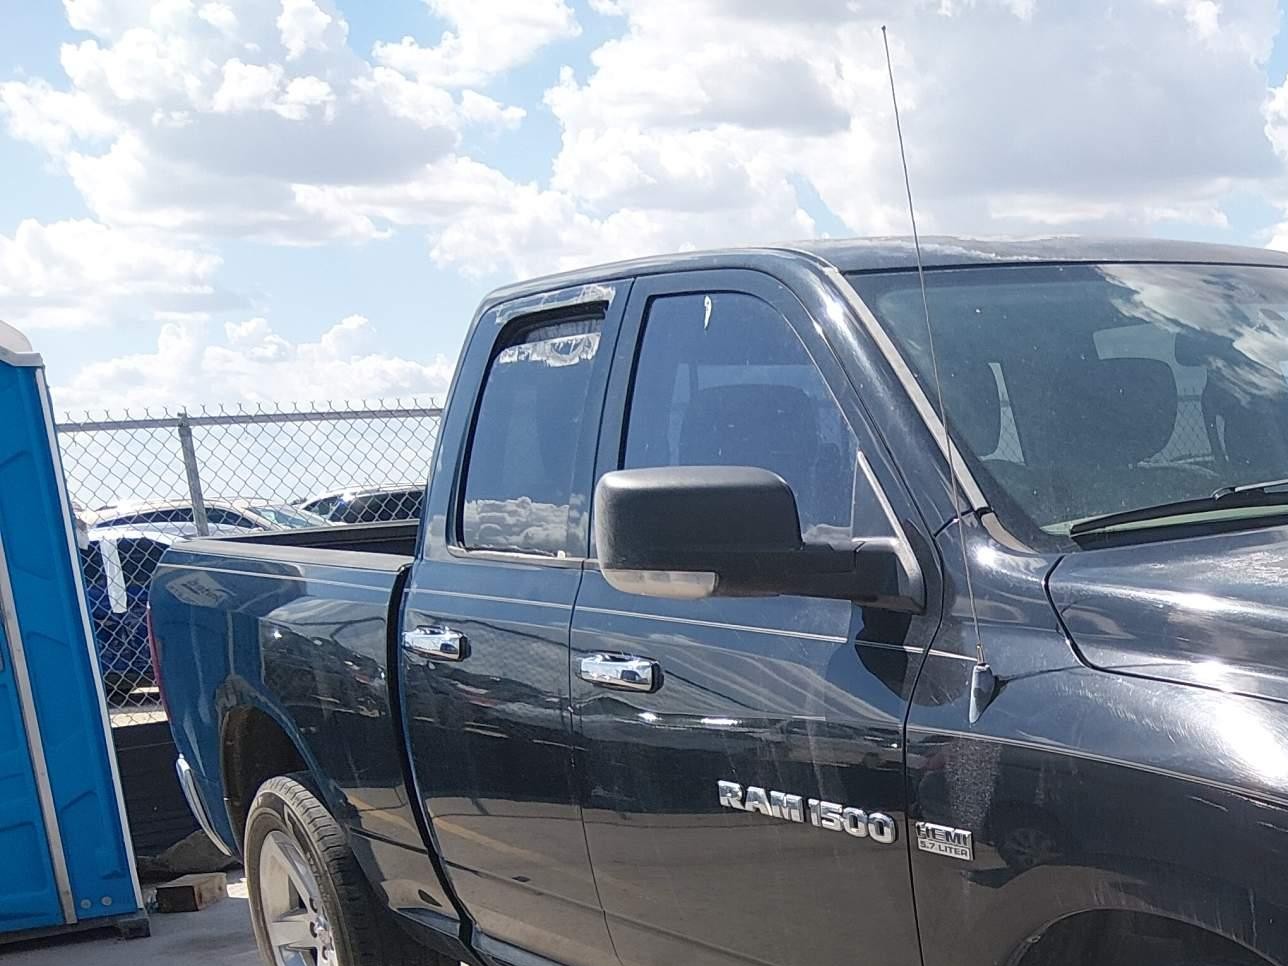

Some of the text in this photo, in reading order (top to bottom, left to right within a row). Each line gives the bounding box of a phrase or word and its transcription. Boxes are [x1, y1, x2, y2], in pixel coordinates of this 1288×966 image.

[717, 779, 897, 844] RAM 1500
[915, 822, 972, 847] HEMI
[919, 840, 968, 857] 5.7 LITER
